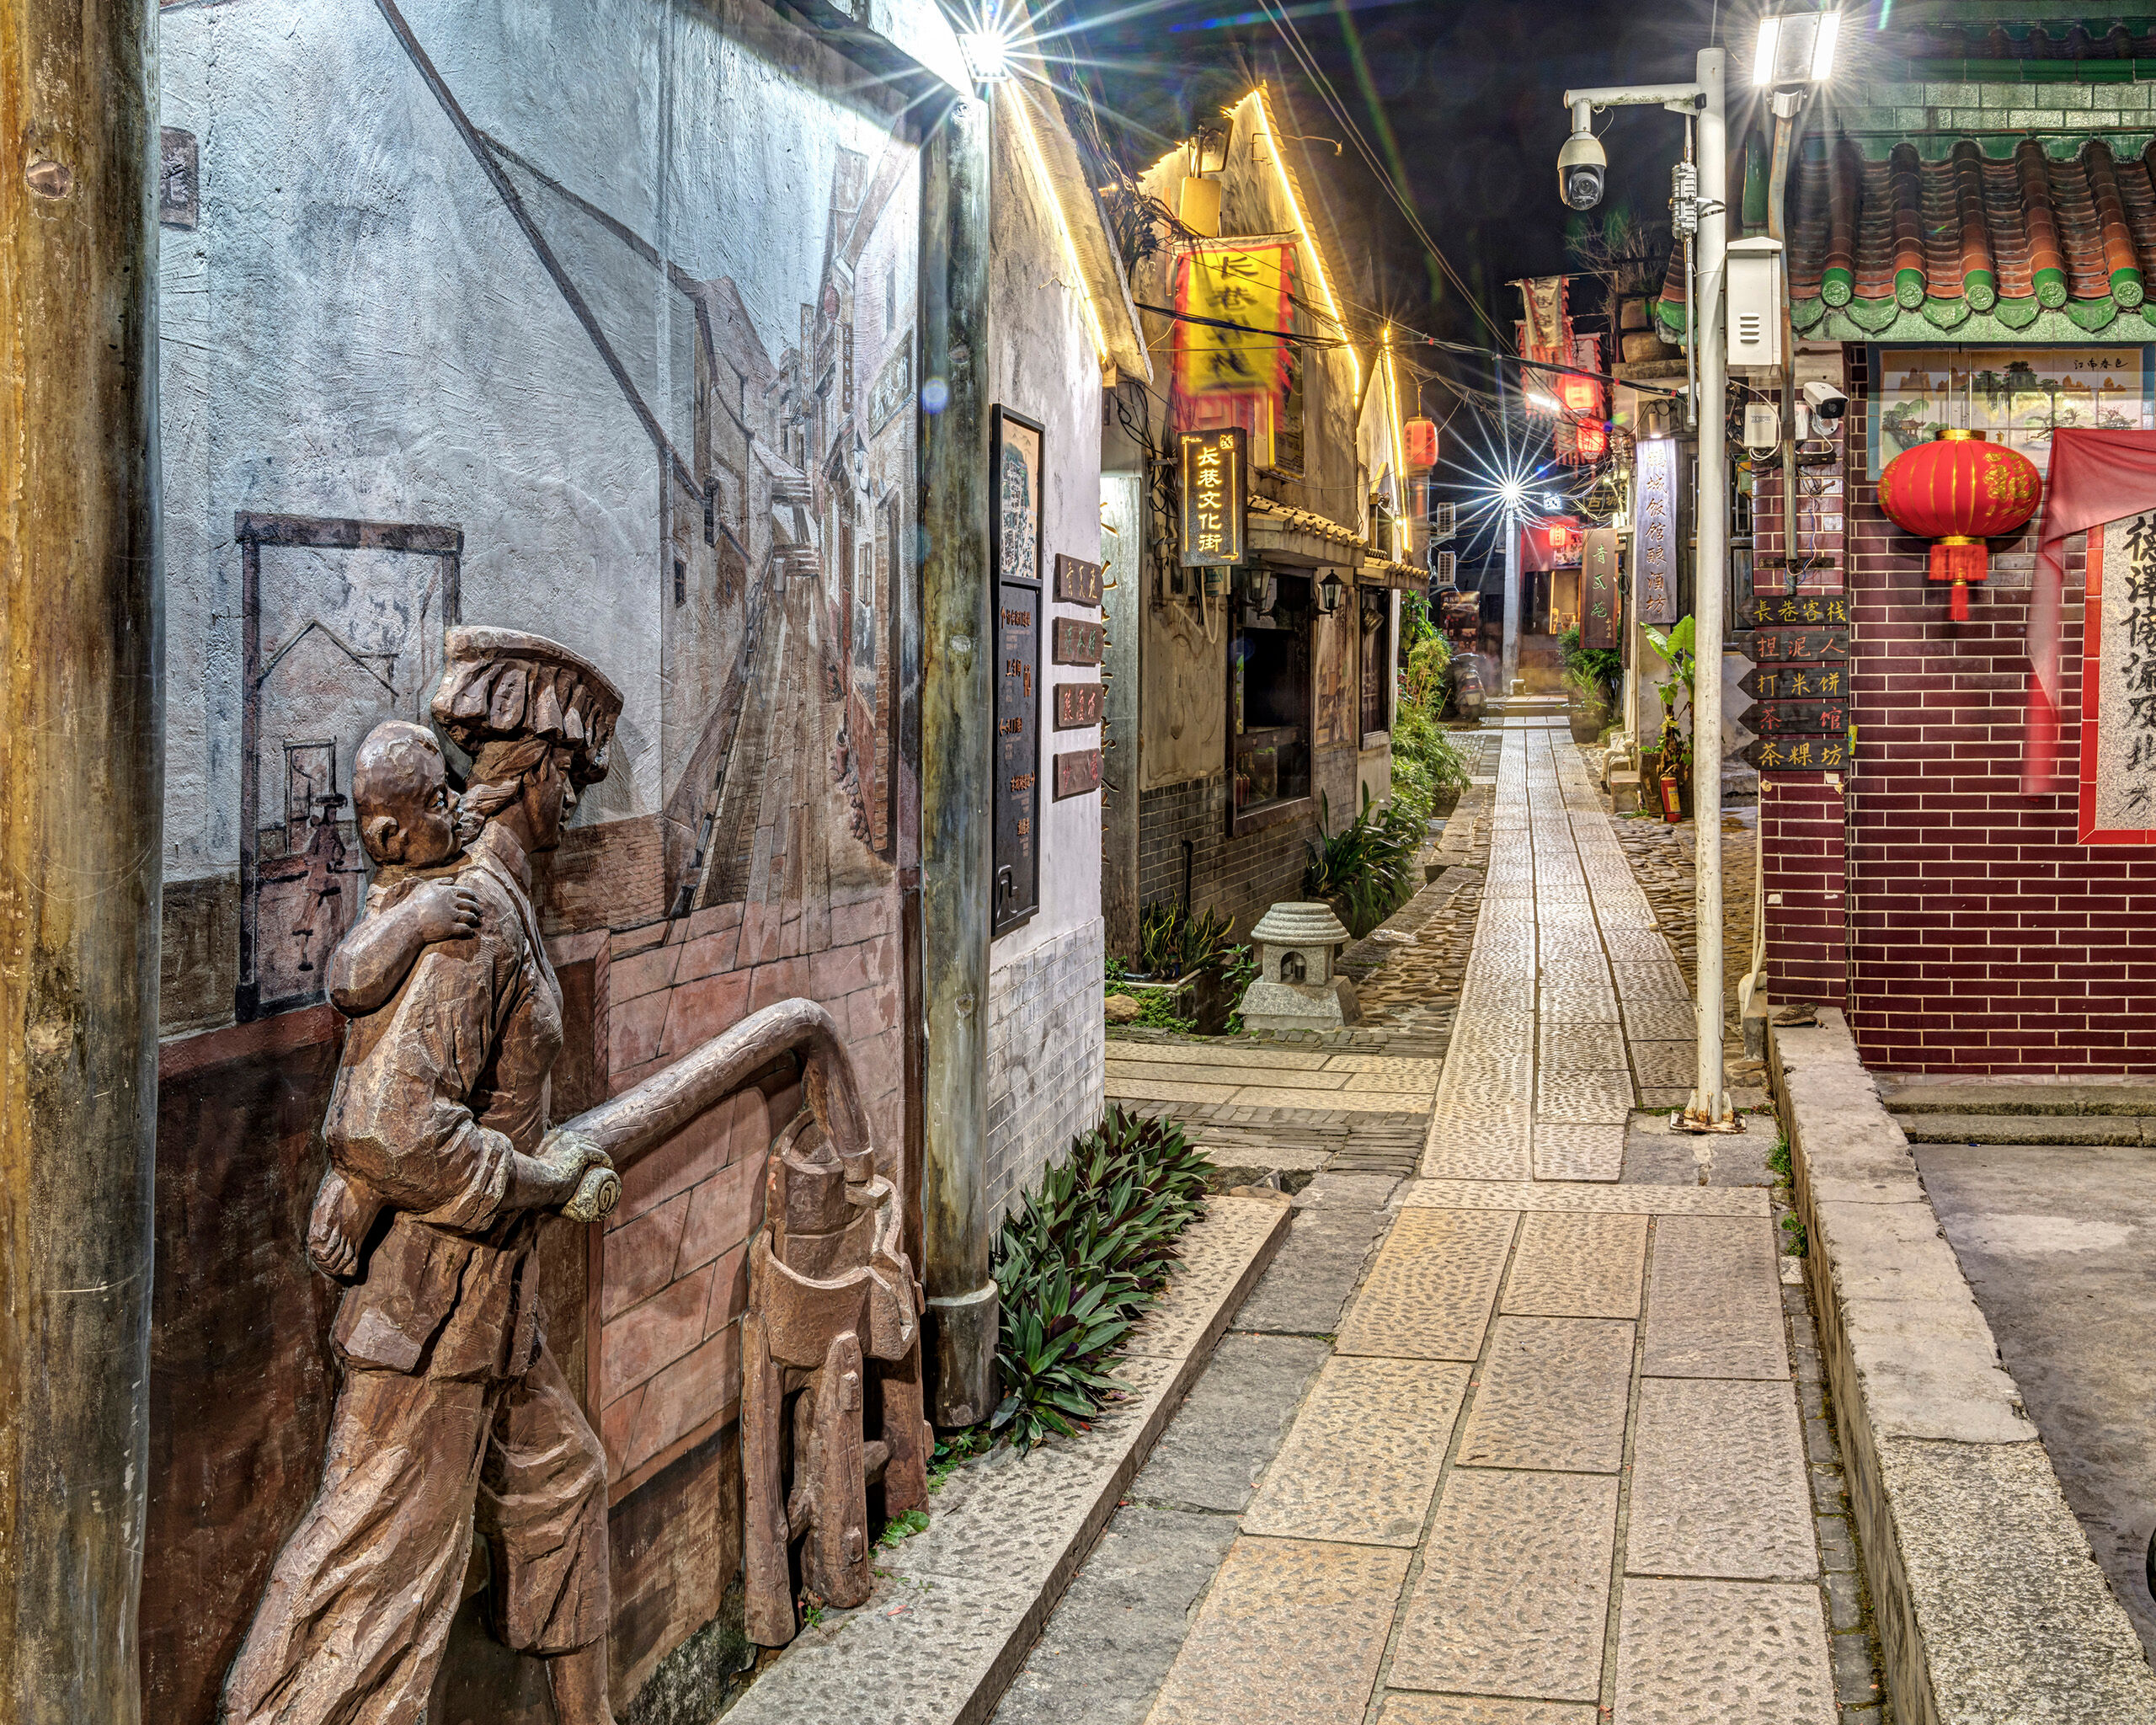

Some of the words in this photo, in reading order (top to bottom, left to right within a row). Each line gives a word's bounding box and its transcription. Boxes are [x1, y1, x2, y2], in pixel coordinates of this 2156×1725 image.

[2073, 357, 2128, 371] 江南春色
[1198, 447, 1223, 553] 长巷文化街
[1753, 600, 1847, 622] 長巷客栈
[1757, 636, 1846, 658] 捏泥人
[1758, 672, 1840, 697] 打米饼
[1760, 706, 1843, 730] 茶馆
[1758, 742, 1843, 766] 茶粿坊
